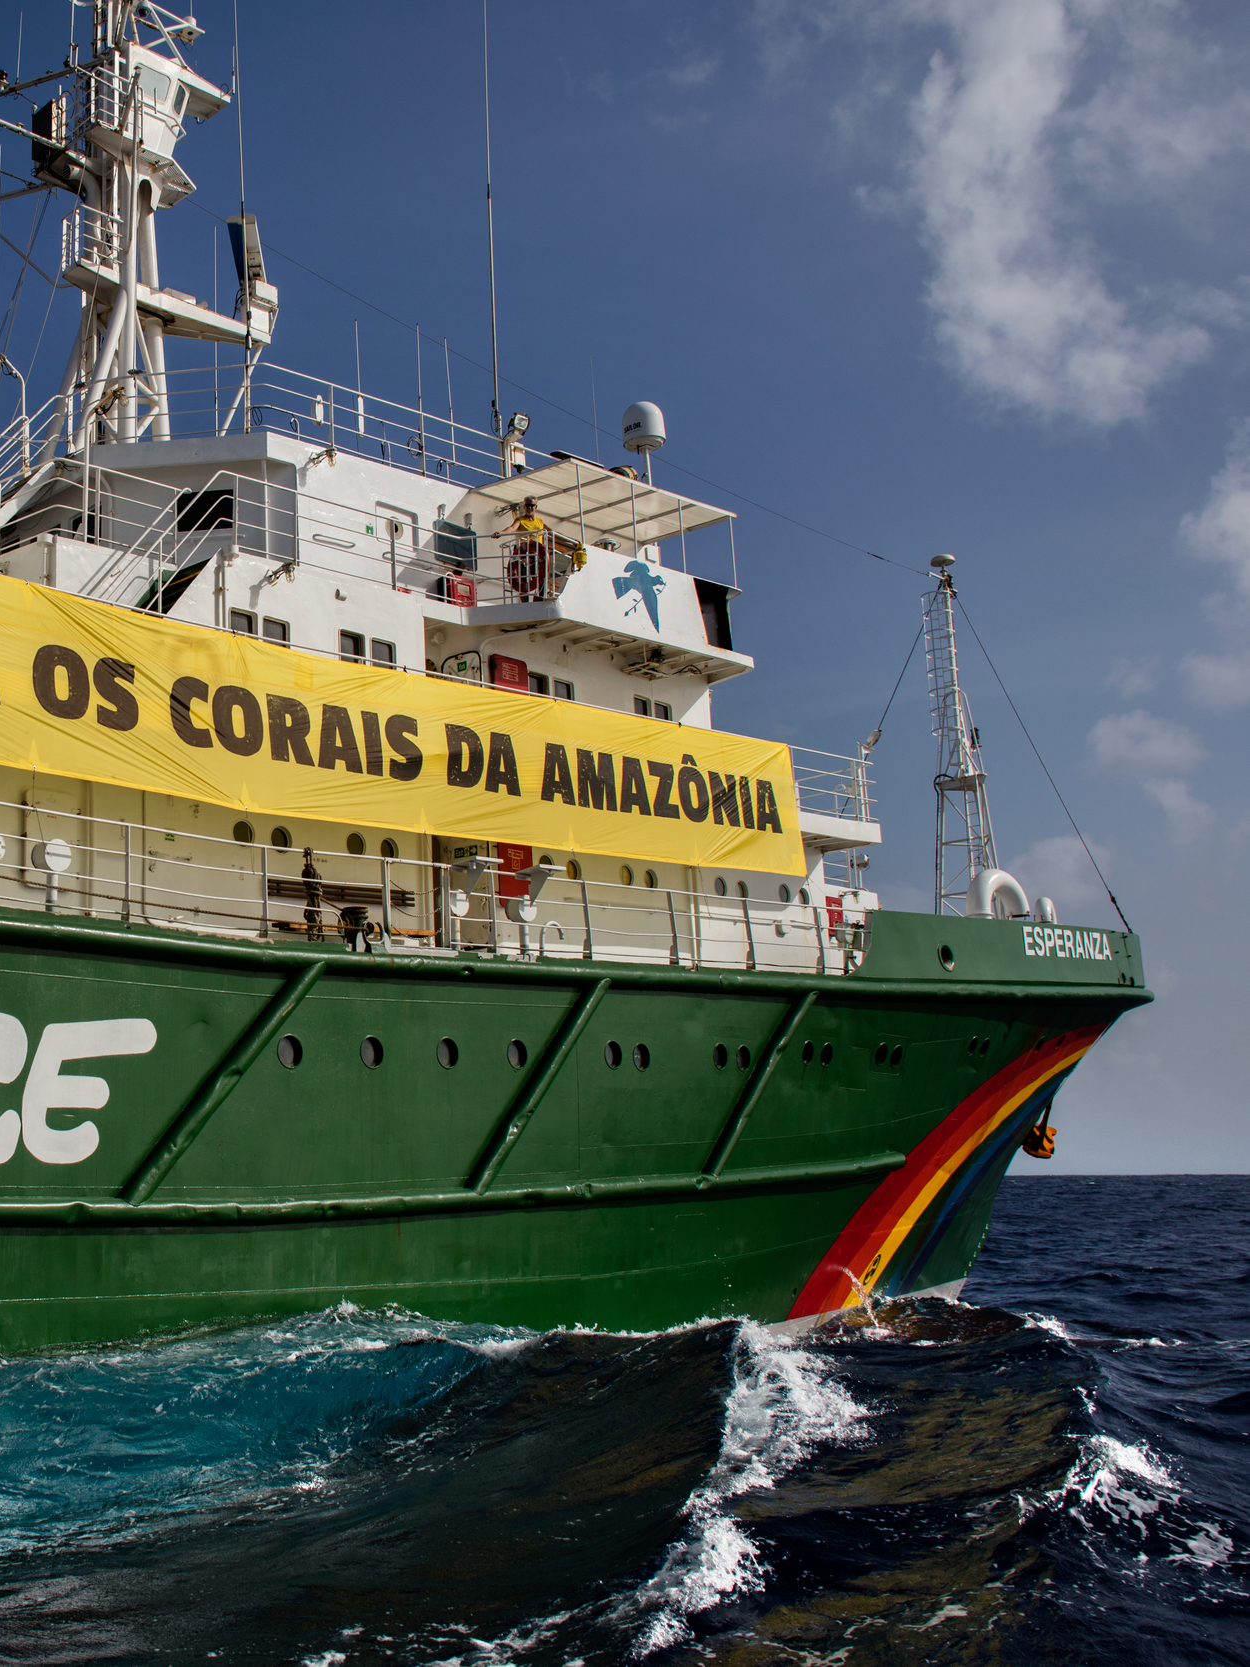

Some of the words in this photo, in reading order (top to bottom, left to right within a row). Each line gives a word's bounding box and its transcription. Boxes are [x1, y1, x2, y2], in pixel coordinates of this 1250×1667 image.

[623, 421, 642, 434] SAILOR
[32, 644, 139, 731] OS
[169, 676, 423, 782] CORAIS
[444, 723, 522, 797] DA
[541, 742, 783, 834] AMAZÔNIA
[1022, 925, 1113, 961] ESPERANZA
